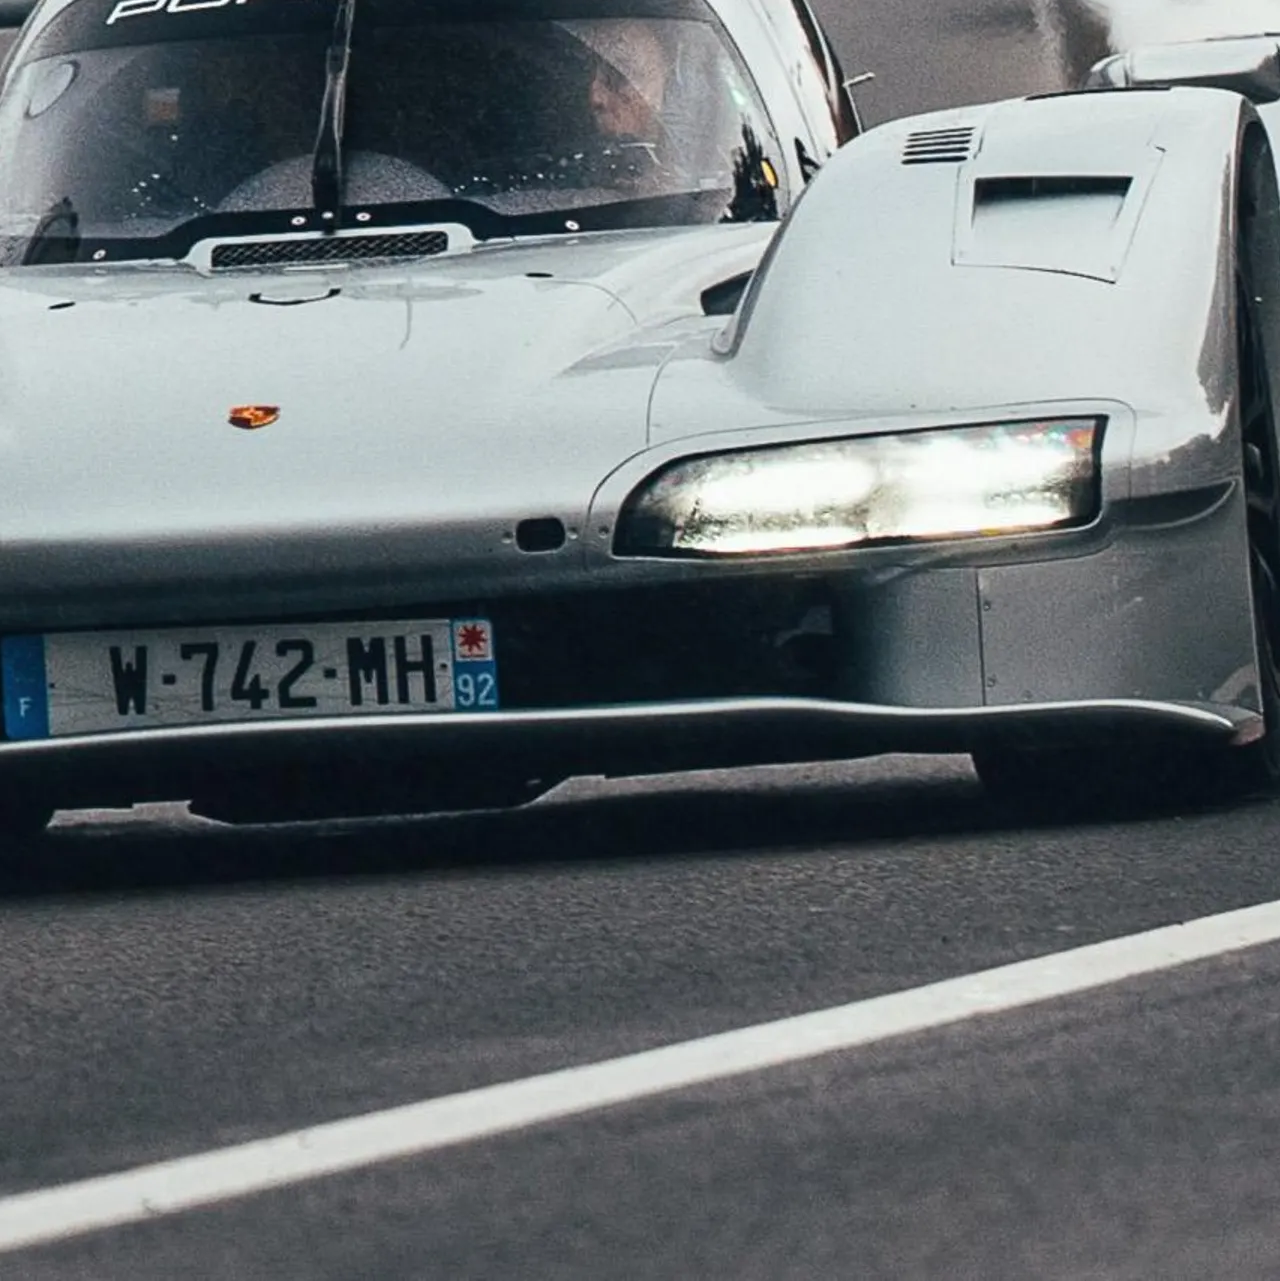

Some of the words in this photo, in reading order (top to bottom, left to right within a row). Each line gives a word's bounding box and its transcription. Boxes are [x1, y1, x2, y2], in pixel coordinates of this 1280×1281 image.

[110, 634, 437, 716] W-742-MH
[457, 673, 497, 707] 92
[18, 696, 32, 717] F
